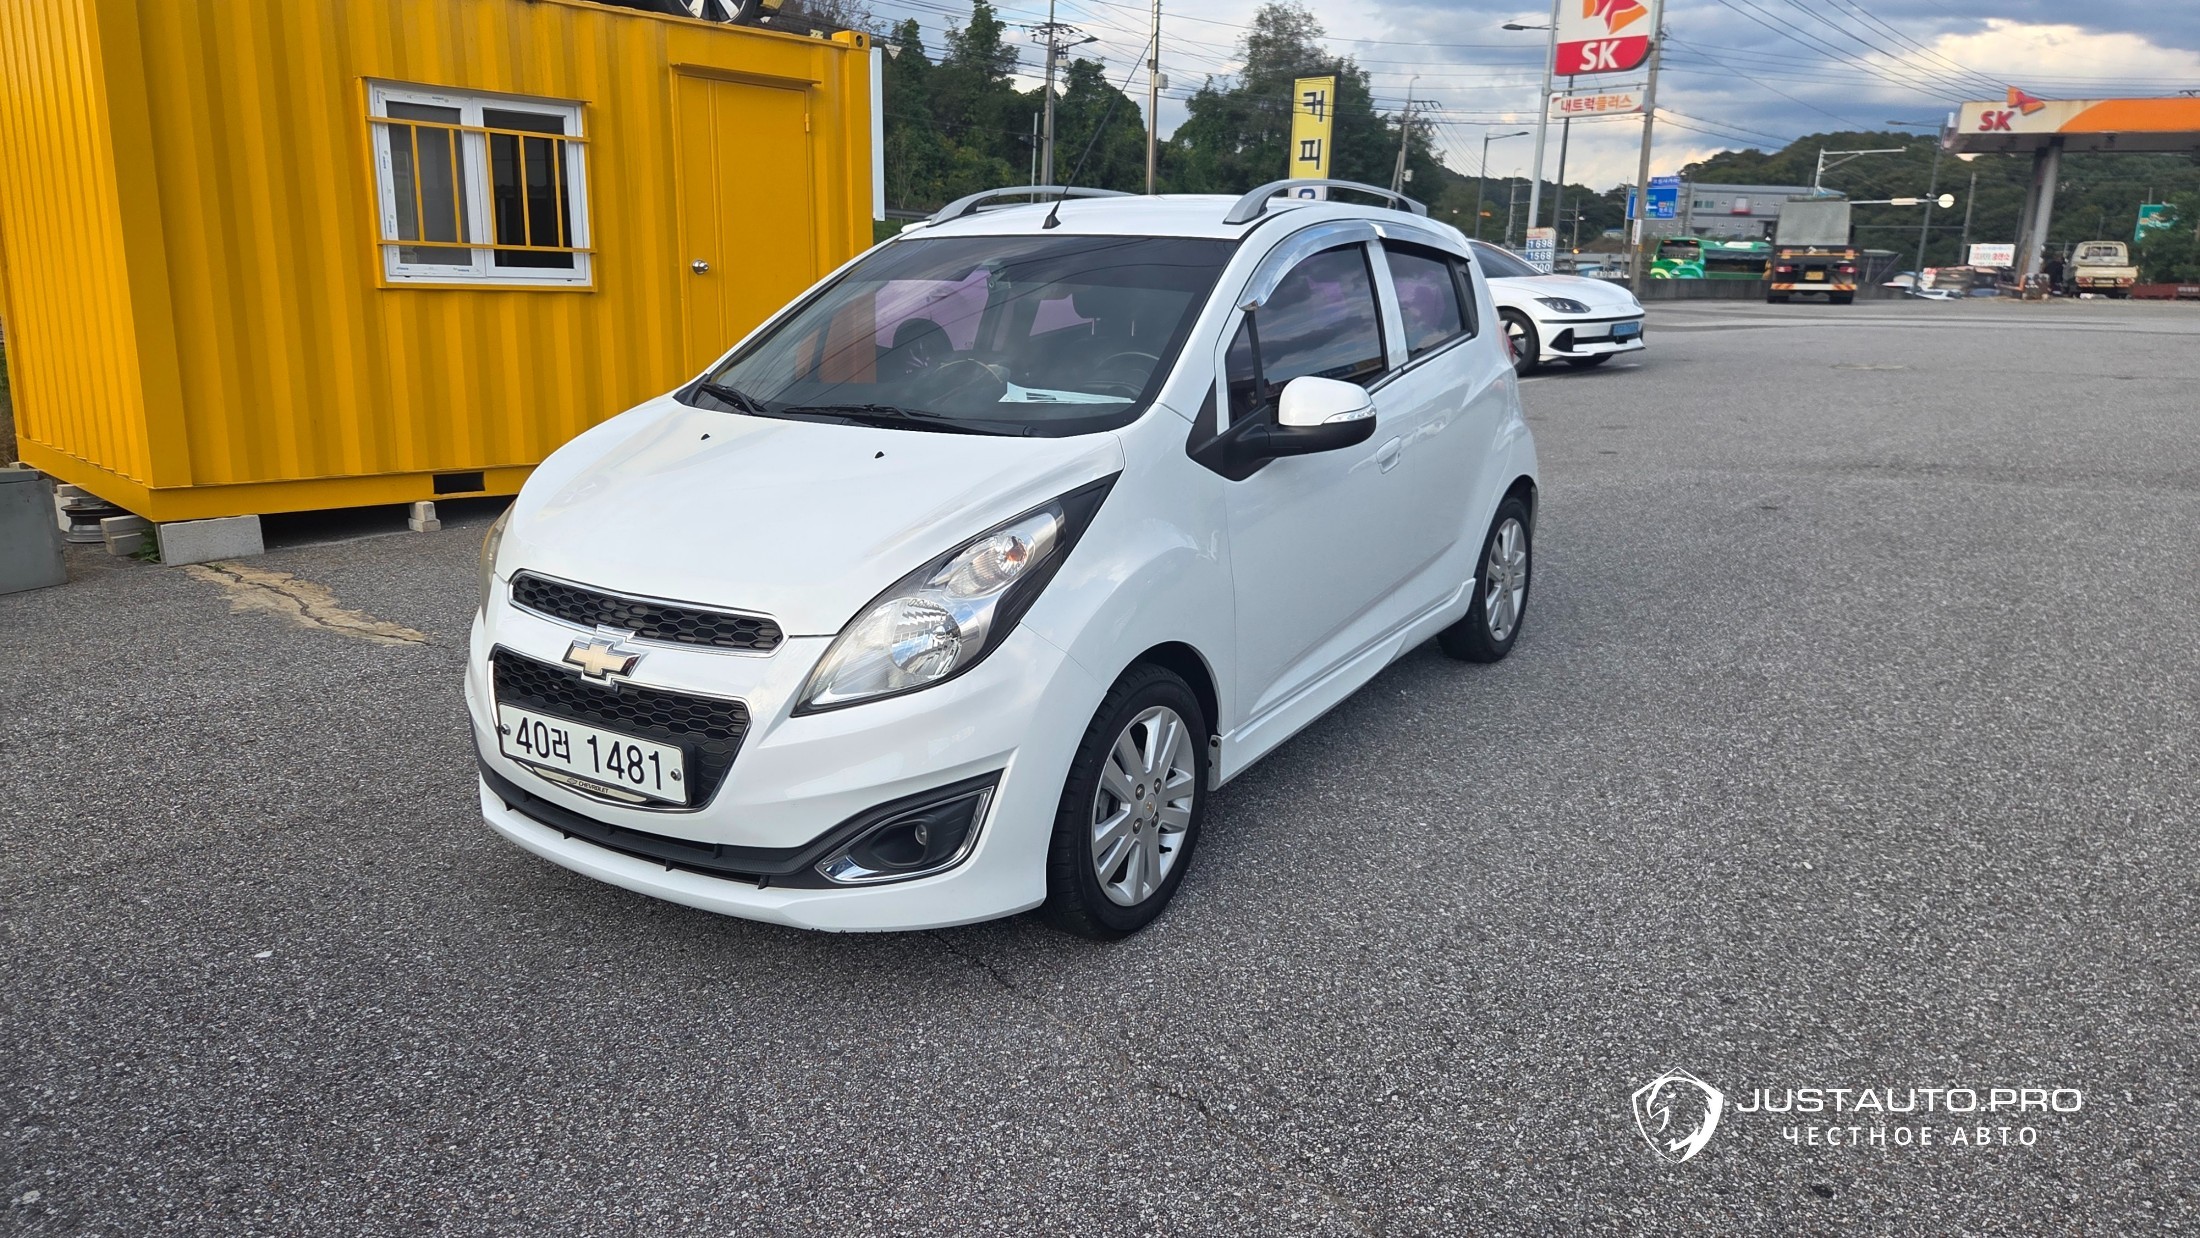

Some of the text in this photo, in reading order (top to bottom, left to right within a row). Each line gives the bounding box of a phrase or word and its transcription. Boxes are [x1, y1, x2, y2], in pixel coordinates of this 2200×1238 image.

[1579, 40, 1621, 71] SK
[1560, 95, 1632, 113] 내트럭플러스
[1298, 90, 1325, 170] 커피
[1978, 111, 2015, 131] SK
[1529, 239, 1553, 249] 1698
[1529, 252, 1552, 261] 1568
[516, 717, 662, 790] 40러 1481
[578, 781, 609, 794] CHEVROLET
